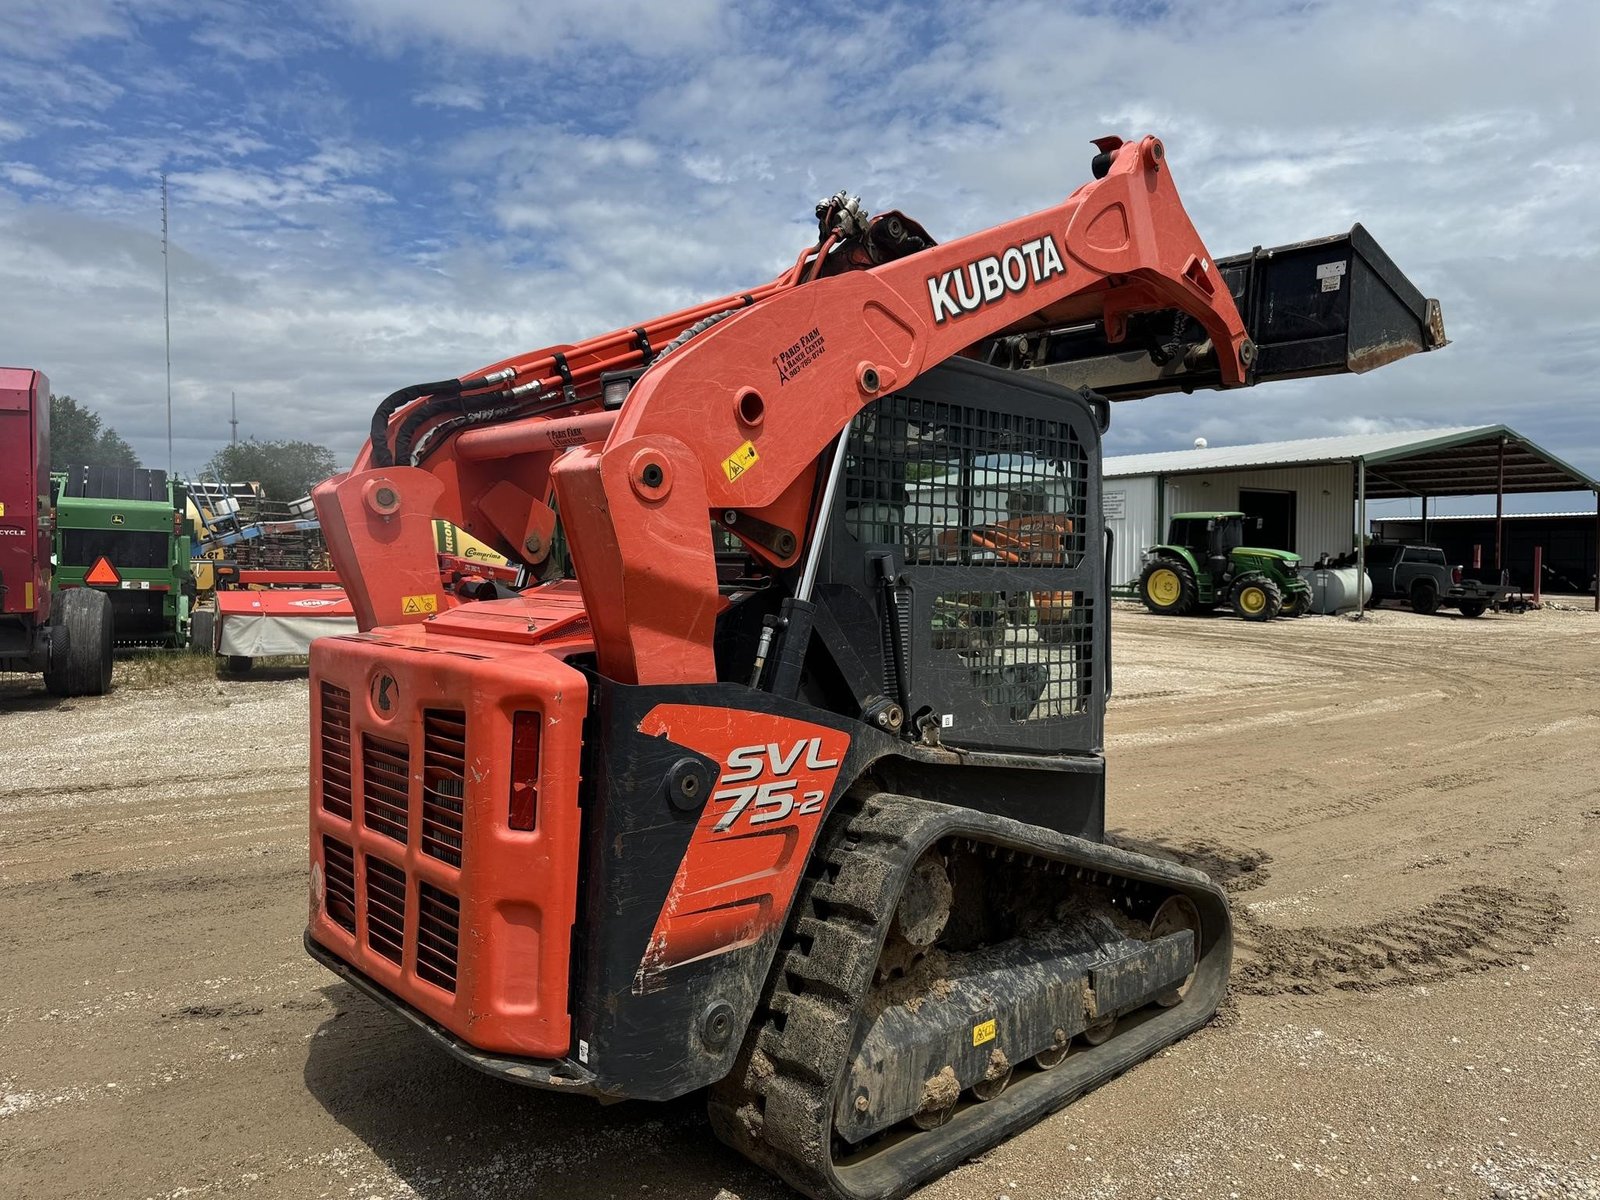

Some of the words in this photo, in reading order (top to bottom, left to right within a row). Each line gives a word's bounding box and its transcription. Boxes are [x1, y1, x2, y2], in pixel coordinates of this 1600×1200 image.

[927, 235, 1065, 323] KUBOTA
[779, 343, 801, 363] PARIS
[799, 327, 820, 347] FARM
[787, 351, 806, 369] RANCH
[804, 336, 825, 355] CENTER
[464, 547, 501, 562] Comprima
[720, 737, 839, 785] SVL
[713, 779, 825, 833] 75-2
